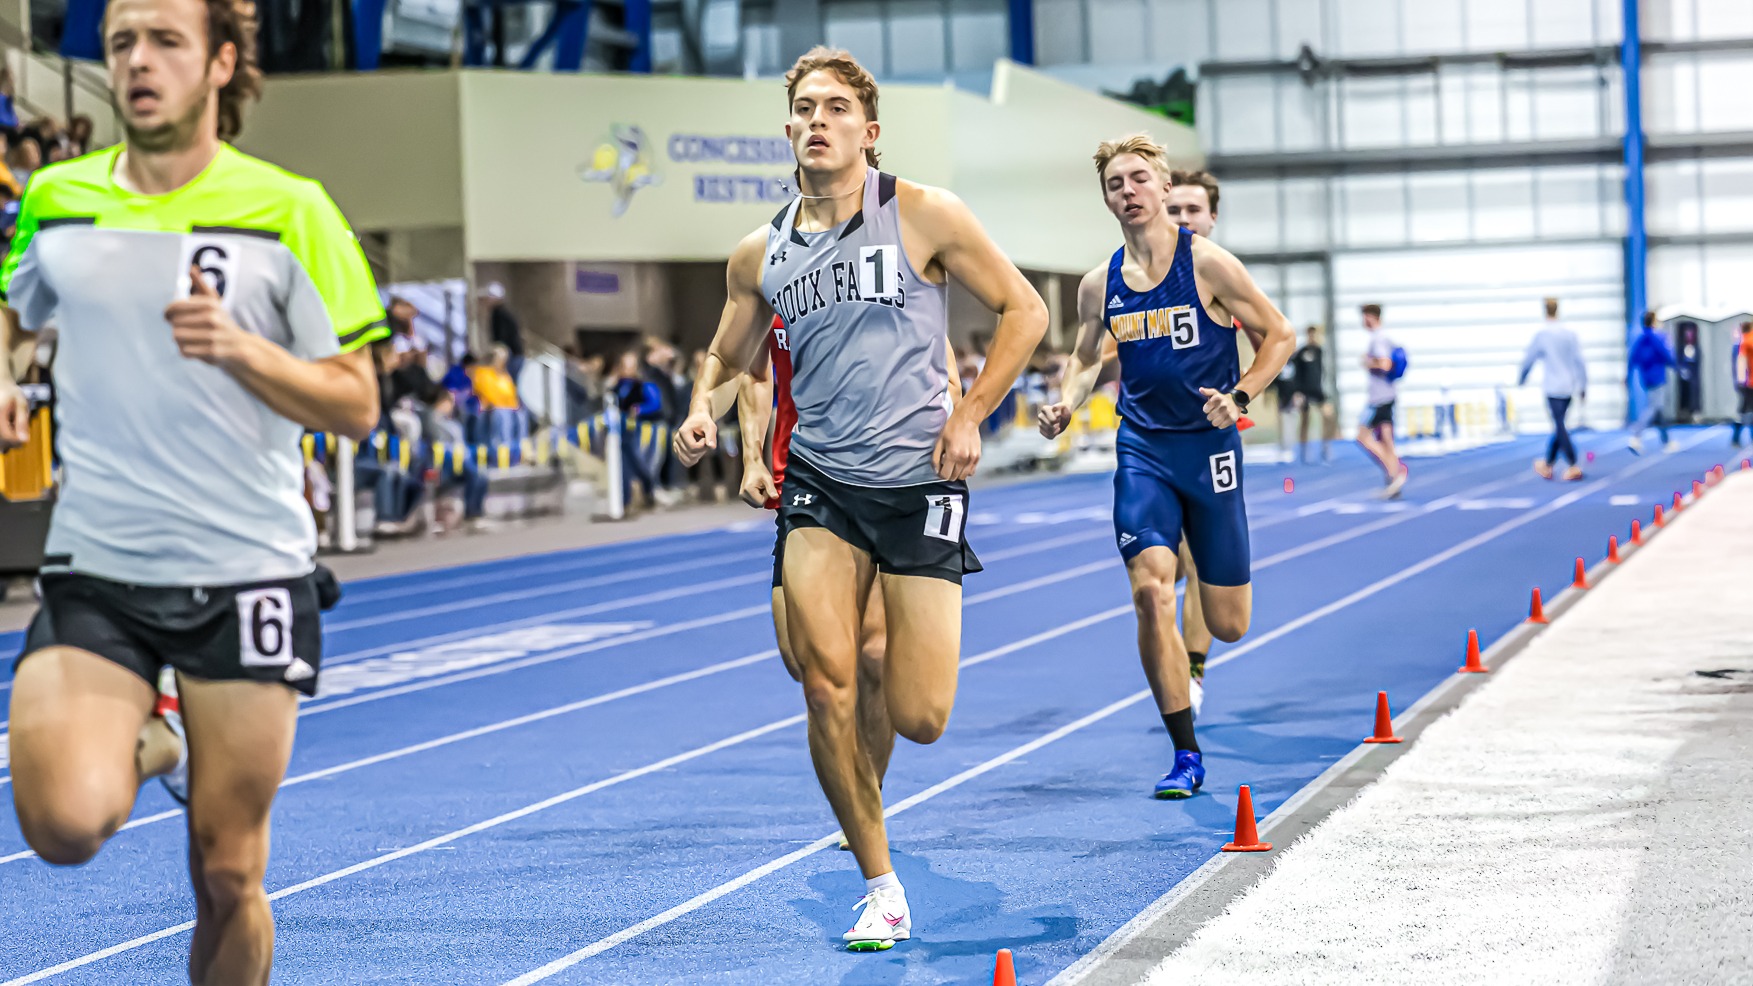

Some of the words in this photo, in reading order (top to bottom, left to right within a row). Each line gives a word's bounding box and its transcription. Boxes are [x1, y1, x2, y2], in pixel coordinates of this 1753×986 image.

[668, 134, 797, 163] CONCESSI
[695, 175, 797, 202] RESTRO
[190, 245, 227, 298] 6
[831, 261, 906, 311] FAS
[865, 248, 885, 294] 1
[1109, 311, 1146, 342] MOUNT
[1173, 311, 1194, 346] 5
[1214, 455, 1233, 488] 5
[935, 496, 953, 537] 1
[252, 596, 283, 657] 6
